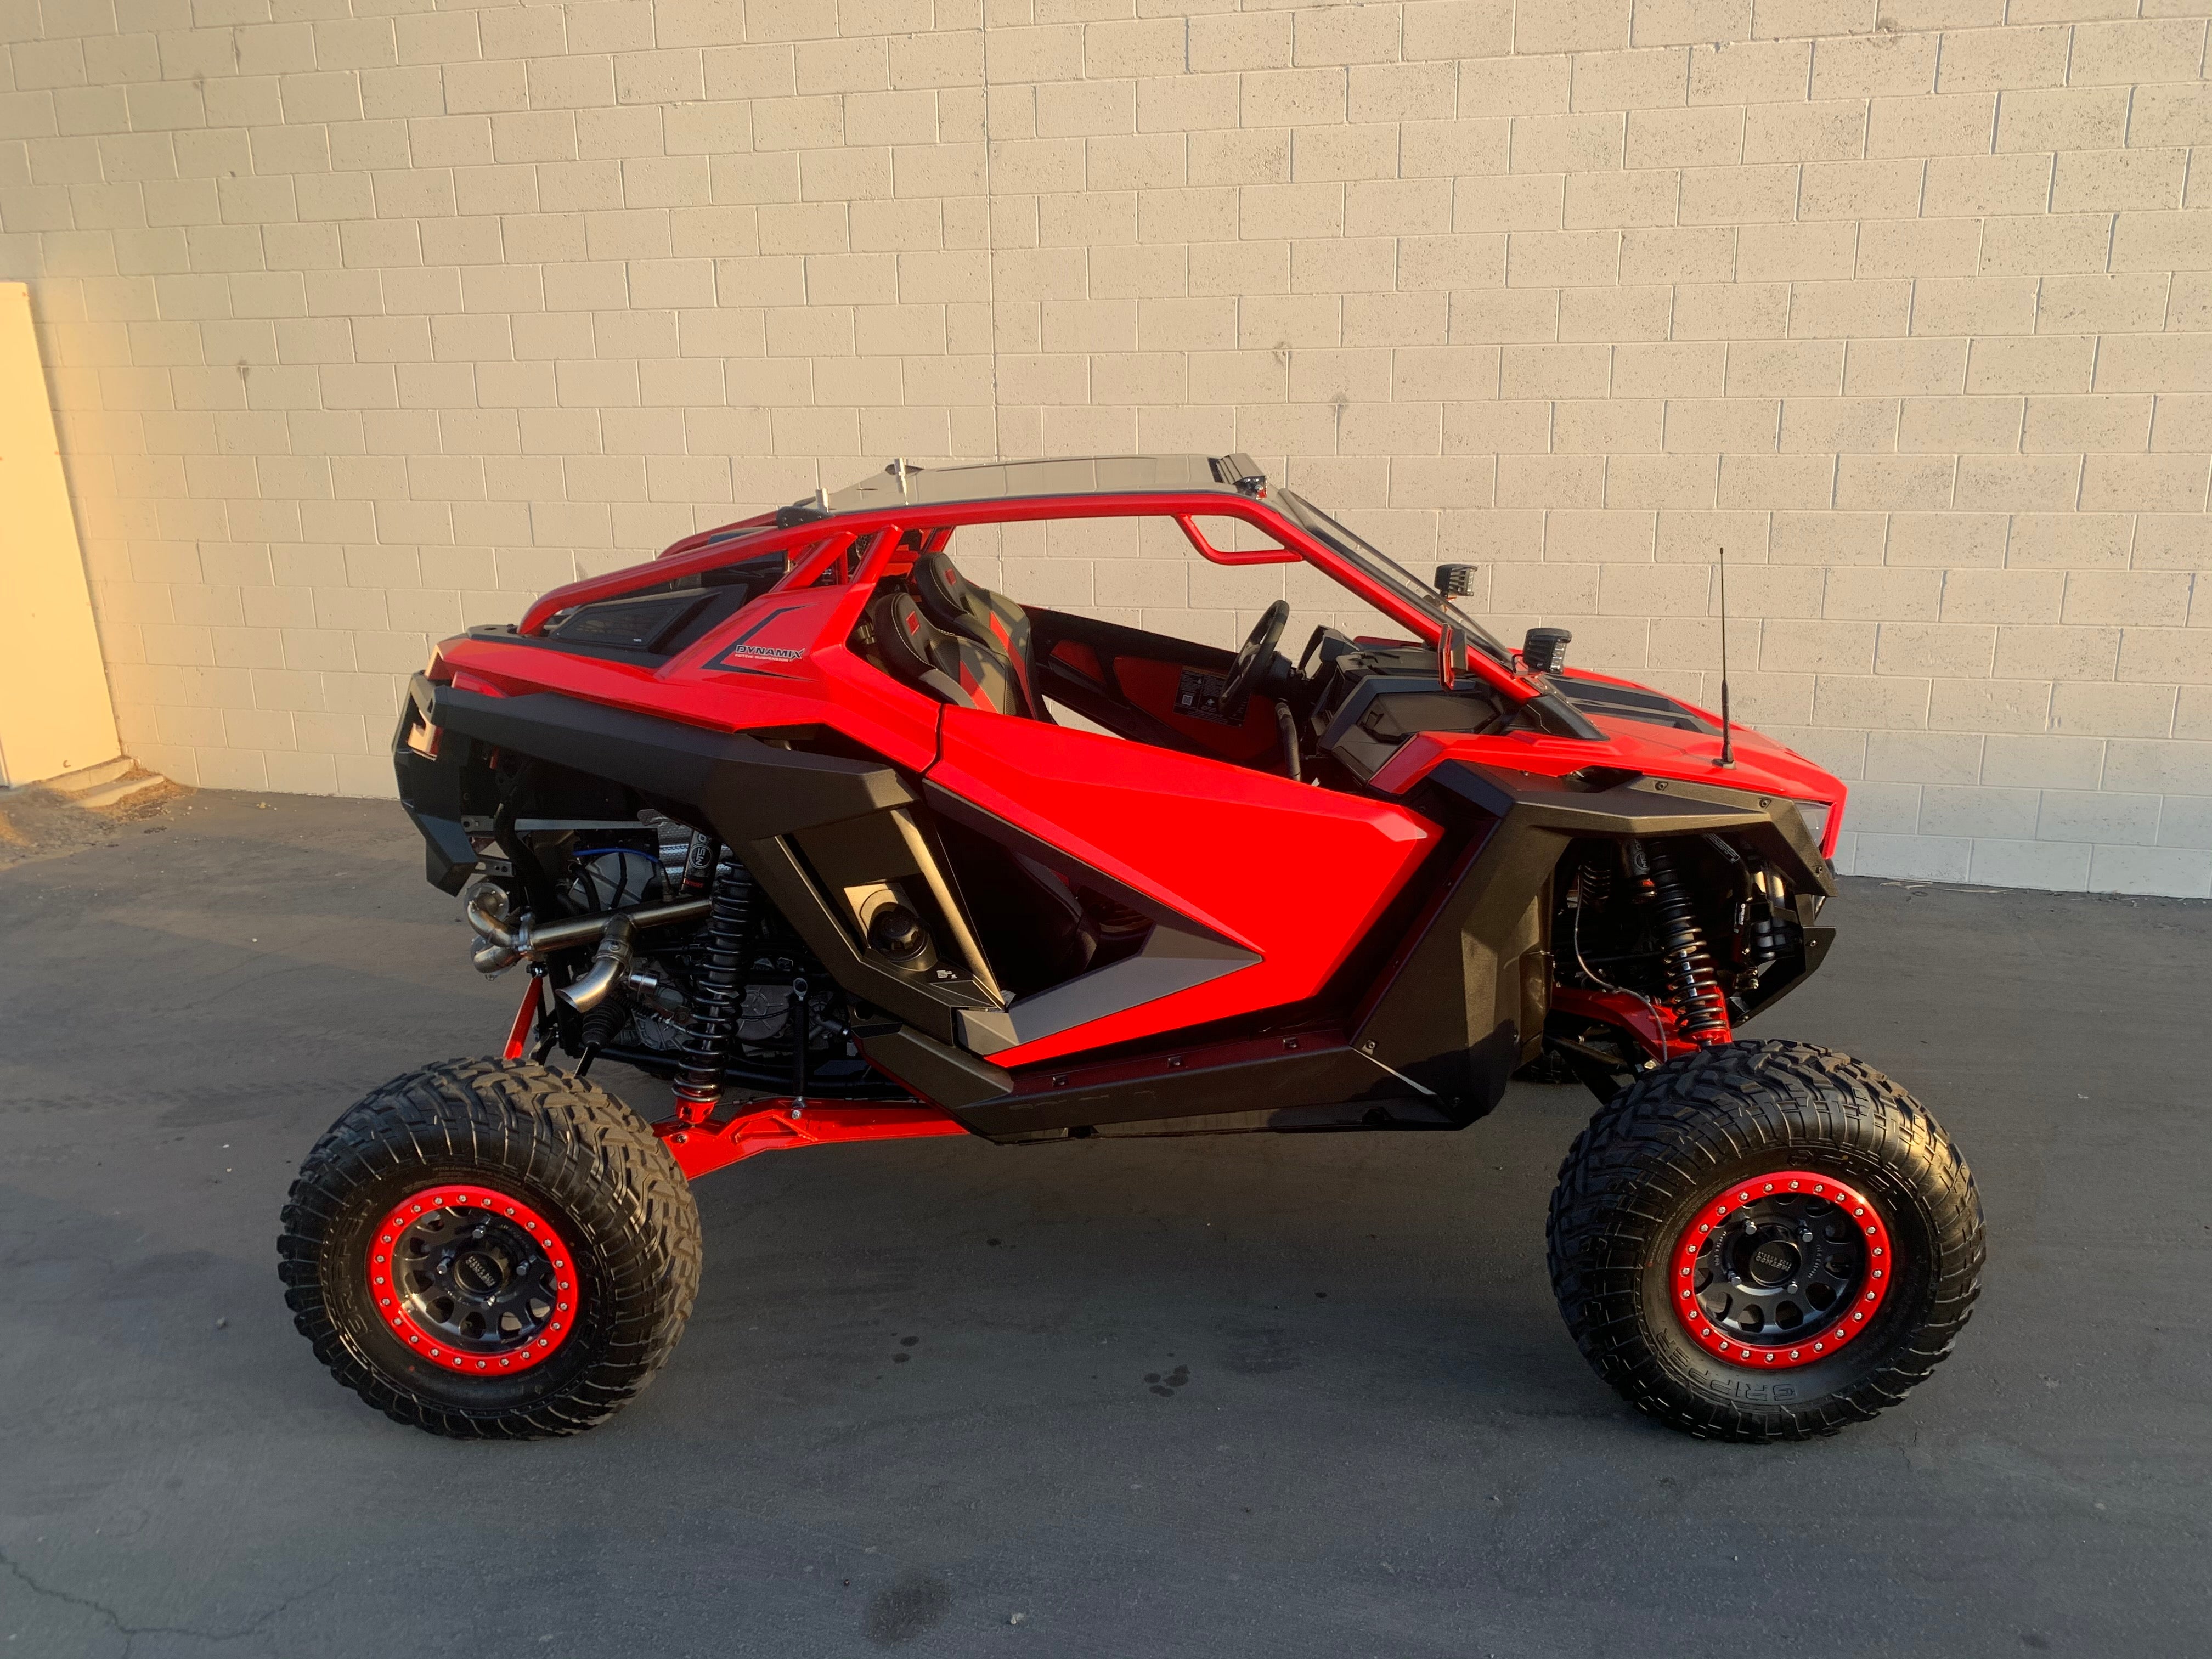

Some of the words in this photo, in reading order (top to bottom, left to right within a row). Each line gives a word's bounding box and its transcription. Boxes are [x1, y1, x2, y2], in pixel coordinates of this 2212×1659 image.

[735, 644, 806, 662] DYNAMIX
[695, 847, 706, 866] MTS
[1756, 1255, 1791, 1272] METHOD
[1656, 1327, 1797, 1402] GRIPPER
